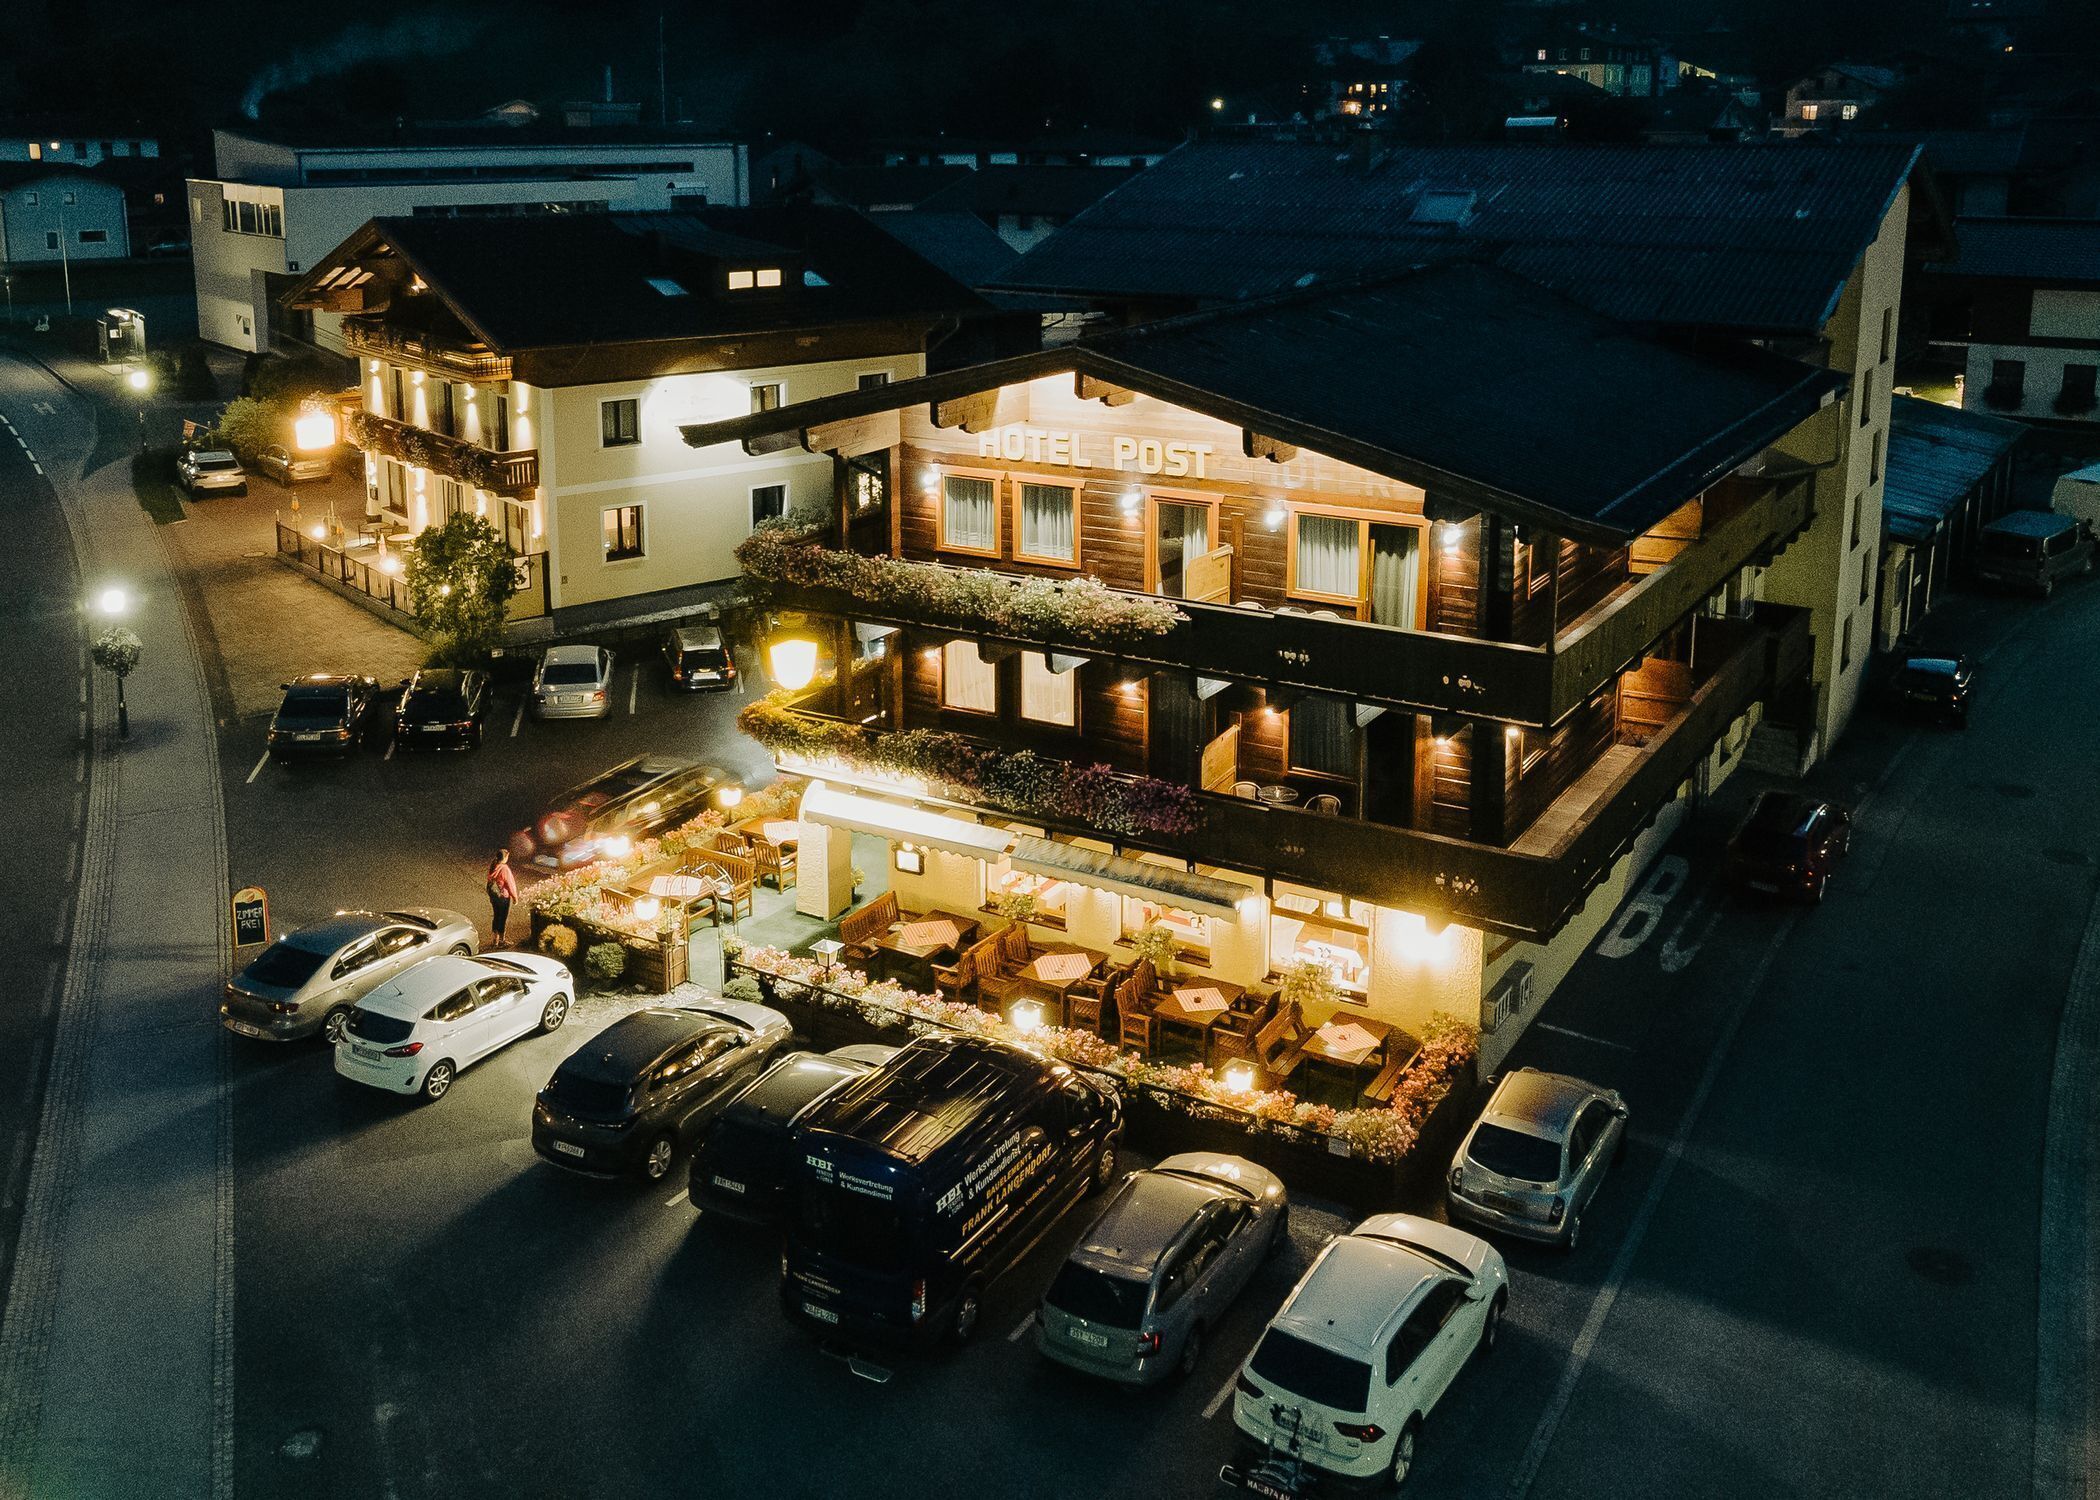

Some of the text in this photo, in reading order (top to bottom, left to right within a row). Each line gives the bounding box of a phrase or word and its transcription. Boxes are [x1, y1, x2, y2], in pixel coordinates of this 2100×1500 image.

[979, 426, 1092, 469] HOTEL
[1113, 435, 1213, 479] POST
[806, 1154, 833, 1172] HBI
[839, 1171, 894, 1193] Werksvertretung
[964, 1131, 1020, 1186] Werksvertretung
[968, 1144, 1021, 1200] & Kundendienst
[986, 1150, 1033, 1199] BAUELEMENTE
[846, 1183, 892, 1201] Kundendienst
[936, 1182, 962, 1213] HBI
[962, 1200, 994, 1236] FRANK
[996, 1142, 1052, 1205] LANGENDORF
